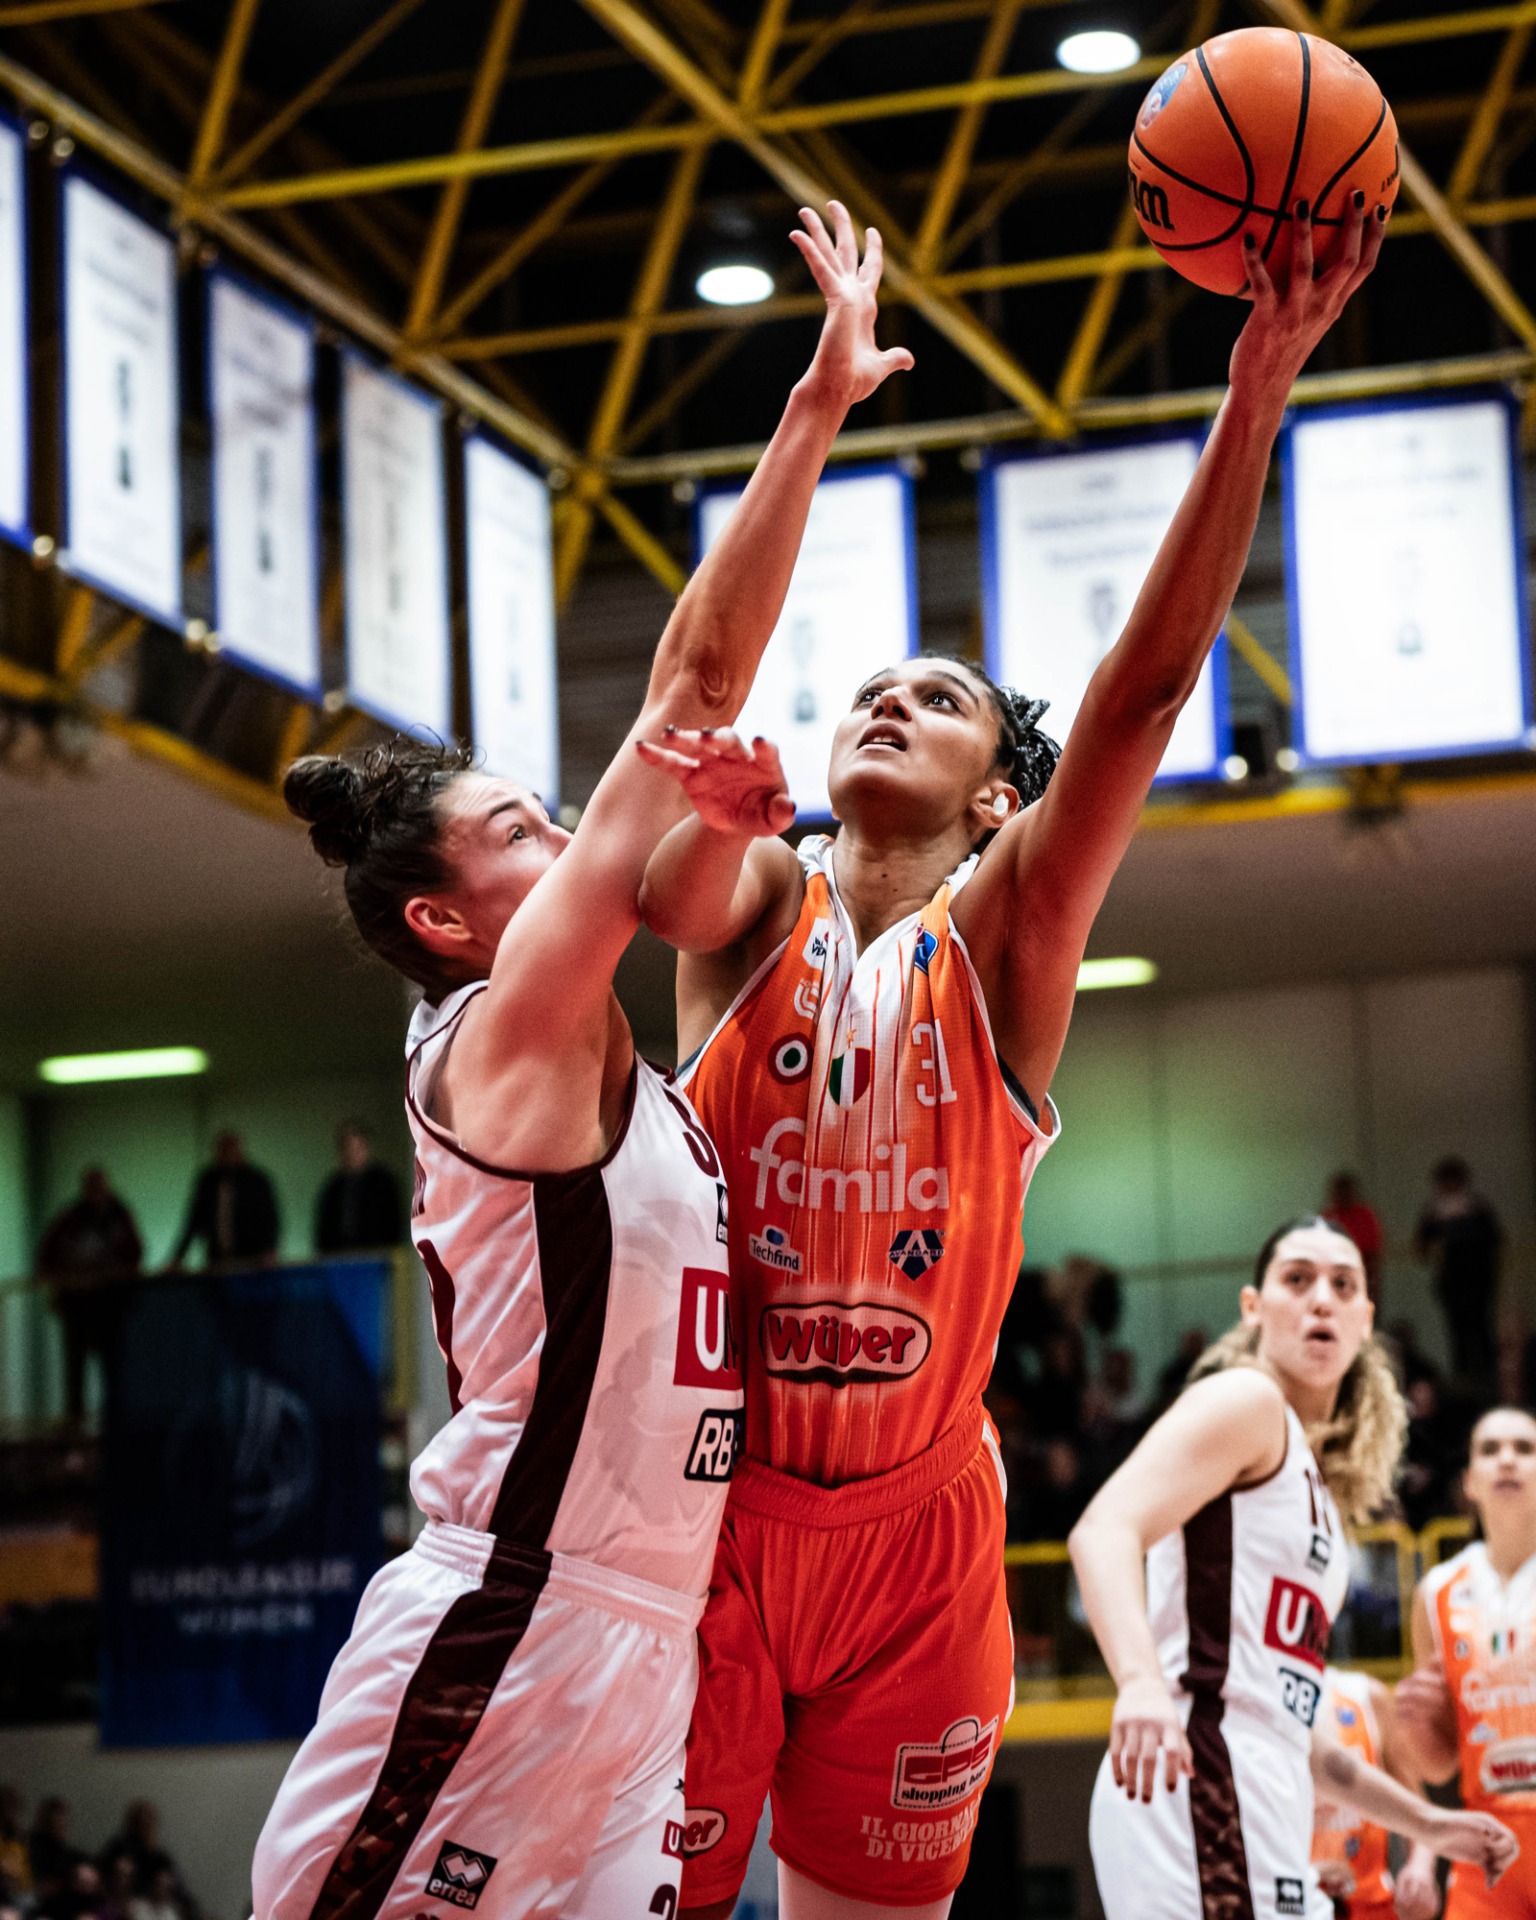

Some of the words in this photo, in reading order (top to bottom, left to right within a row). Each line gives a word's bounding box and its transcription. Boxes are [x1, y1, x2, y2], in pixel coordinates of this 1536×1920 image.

[912, 1018, 957, 1107] 31
[750, 1117, 950, 1213] famila
[751, 1238, 800, 1271] Techfind
[889, 1249, 945, 1259] AVANGARD
[901, 1780, 967, 1803] shopping
[861, 1815, 887, 1837] IL
[892, 1798, 979, 1842] GIORNA
[866, 1837, 895, 1860] DI
[901, 1824, 973, 1862] VICEN
